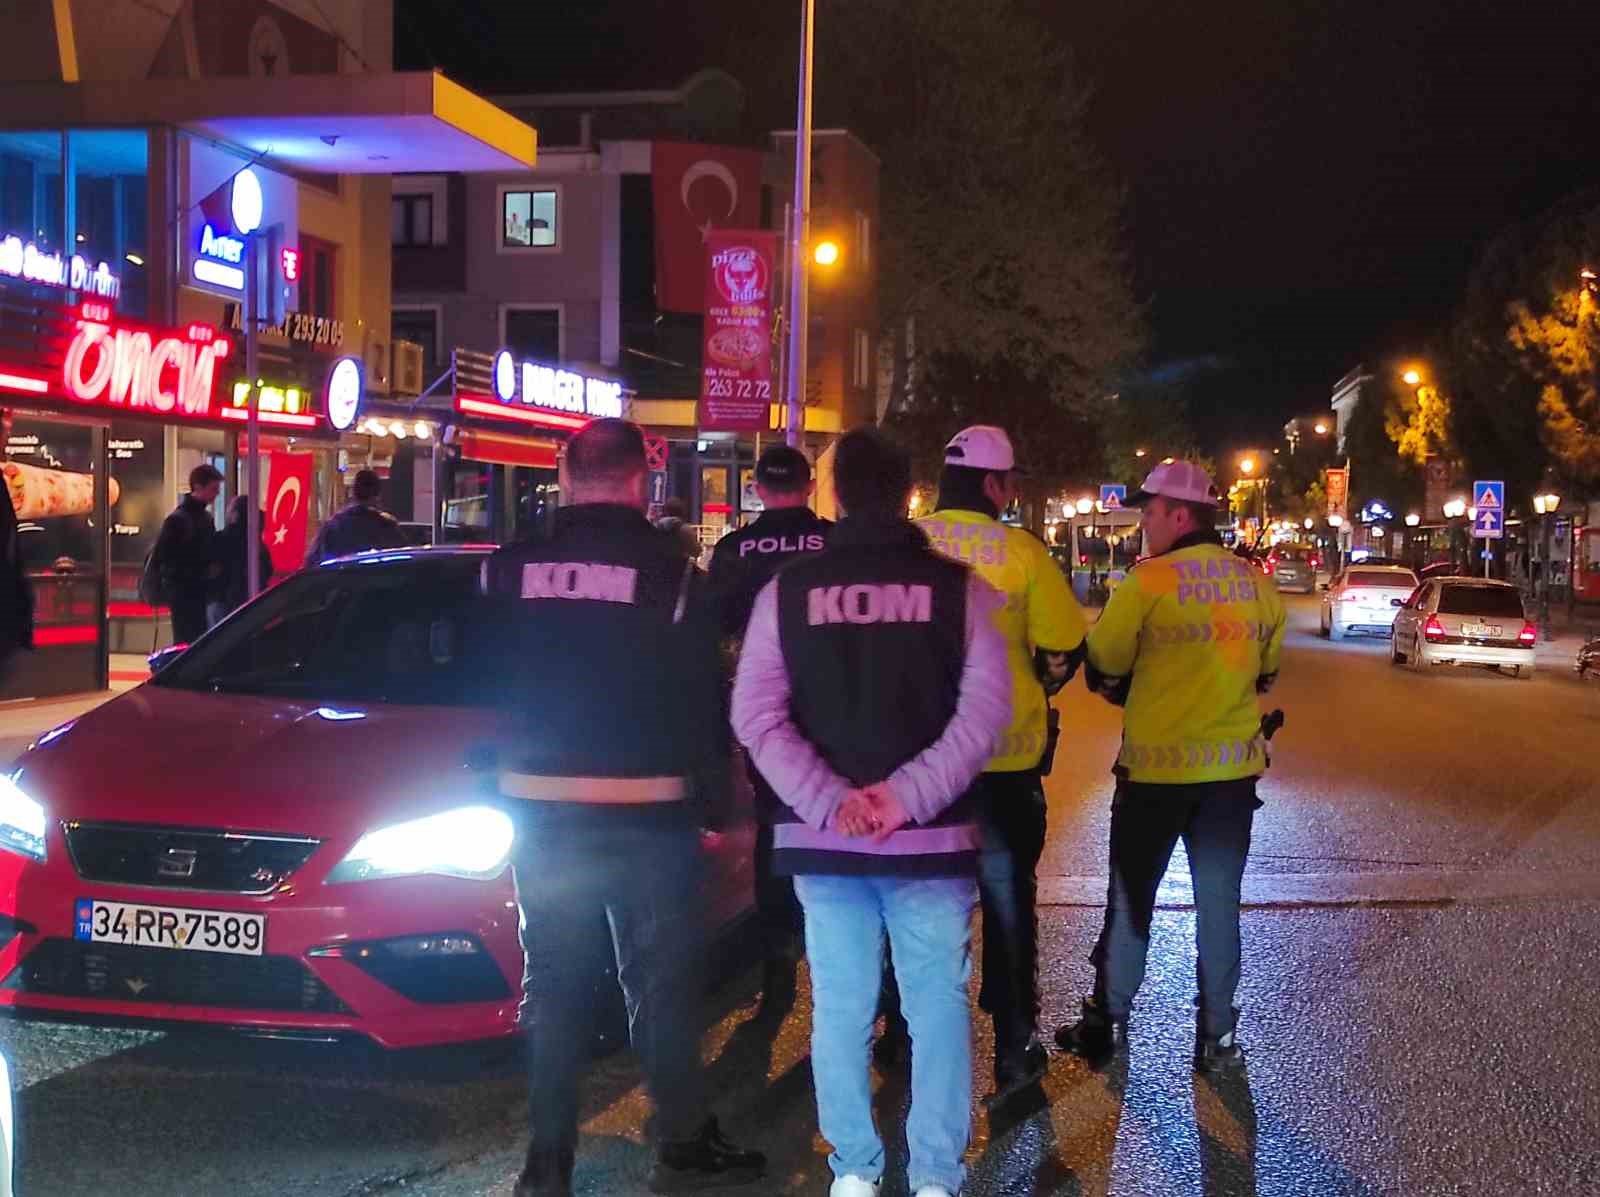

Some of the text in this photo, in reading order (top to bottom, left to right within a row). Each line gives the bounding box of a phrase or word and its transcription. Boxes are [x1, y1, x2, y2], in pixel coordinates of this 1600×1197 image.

[293, 313, 315, 342] 293
[710, 378, 770, 399] 263 72 72
[520, 562, 637, 604] KOM
[808, 583, 932, 626] KOM
[94, 906, 261, 951] 34 RR 7589
